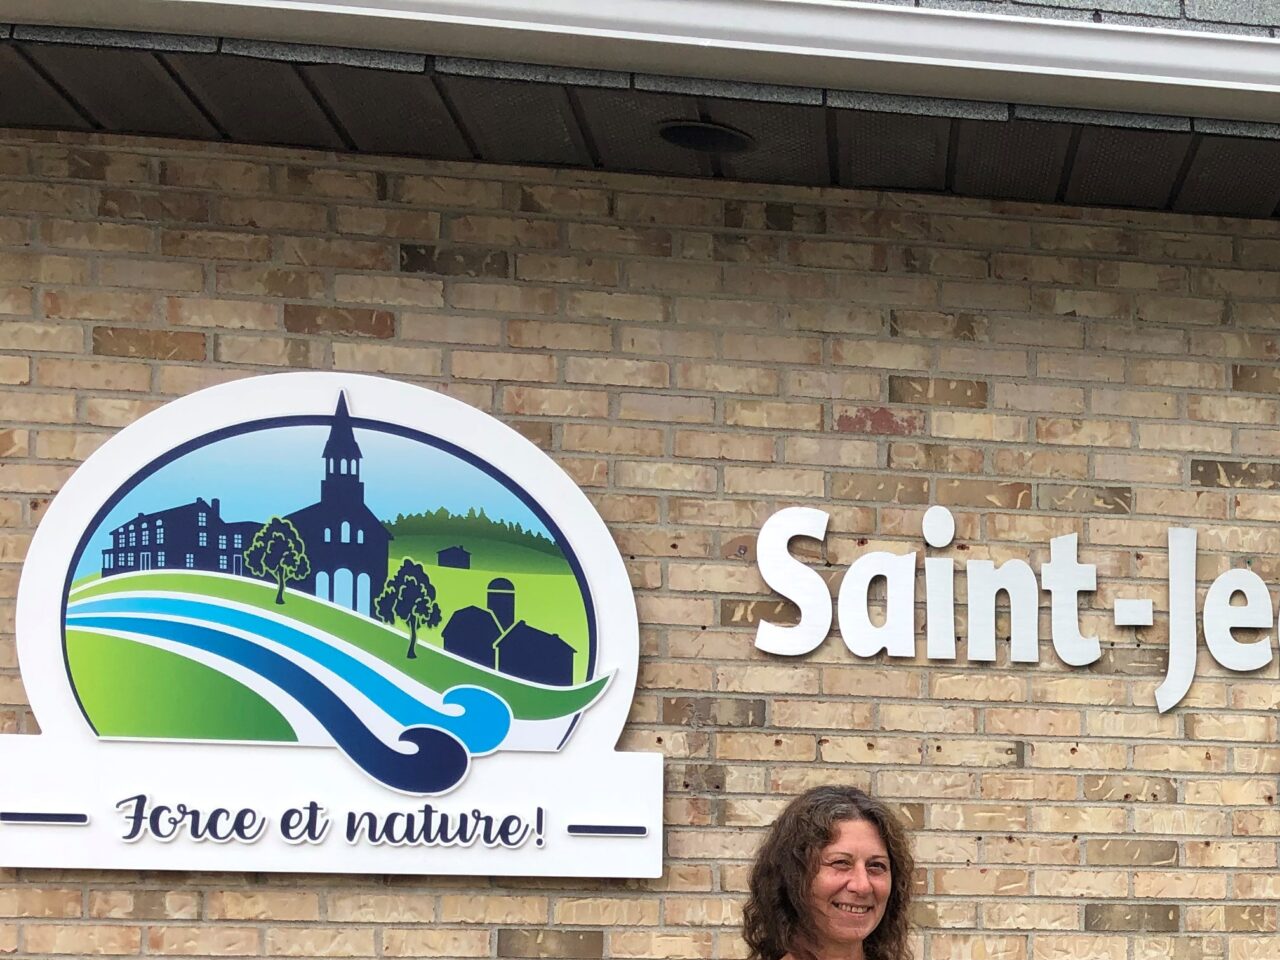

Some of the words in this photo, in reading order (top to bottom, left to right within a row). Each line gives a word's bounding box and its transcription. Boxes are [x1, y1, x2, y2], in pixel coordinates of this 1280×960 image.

[116, 794, 265, 842] Force
[280, 800, 329, 842] et
[346, 803, 545, 847] nature!
